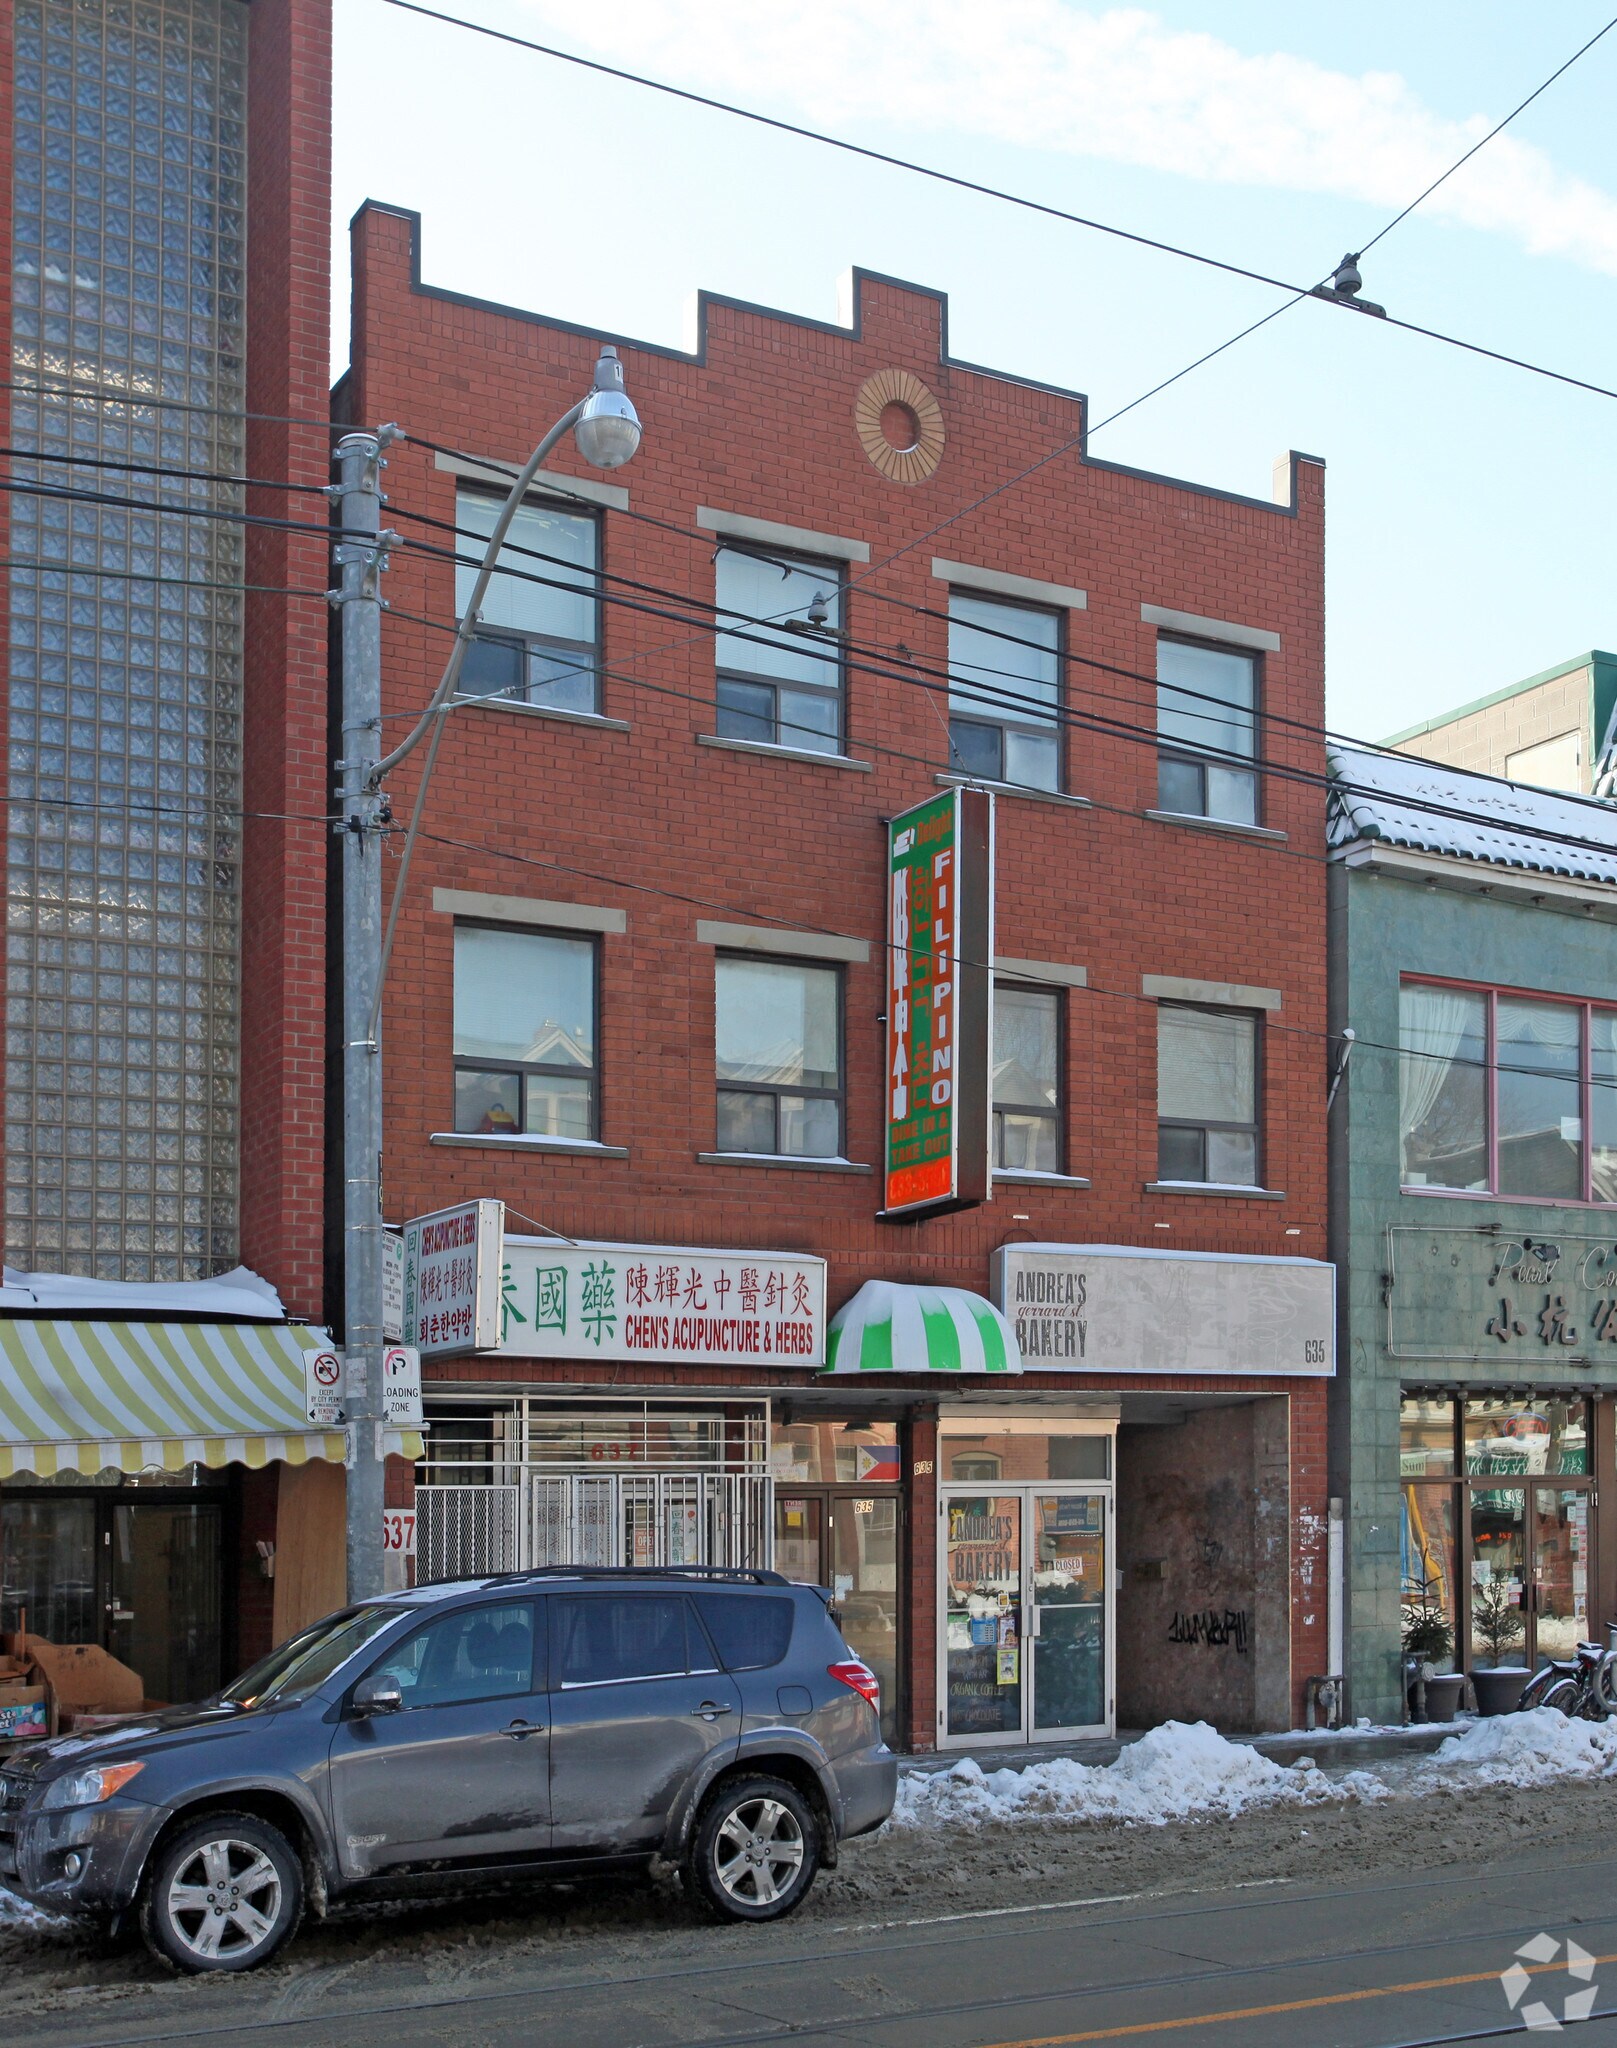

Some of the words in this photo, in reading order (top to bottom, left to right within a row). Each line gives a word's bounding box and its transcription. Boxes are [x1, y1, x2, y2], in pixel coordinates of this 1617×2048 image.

[932, 850, 953, 1105] FILIPINO
[891, 1120, 919, 1144] DINE
[923, 1116, 935, 1134] IN
[891, 1142, 921, 1166] TAKE
[924, 1133, 949, 1156] OUT
[626, 1263, 813, 1316] 陳輝光中醫針灸
[1016, 1271, 1087, 1305] ANDREA'S
[419, 1305, 473, 1346] 회춘한약방
[625, 1314, 669, 1350] CHEN'S
[672, 1316, 760, 1353] ACUPUNCTURE
[763, 1320, 771, 1353] &
[775, 1321, 813, 1355] HERBS
[1015, 1319, 1088, 1358] BAKERY
[1304, 1339, 1325, 1364] 635
[391, 1402, 410, 1412] ZONE
[1506, 1420, 1549, 1437] OPEN
[591, 1443, 639, 1461] 637
[914, 1461, 934, 1474] 635
[1402, 1459, 1425, 1472] Sum
[855, 1501, 874, 1513] 635
[956, 1516, 1013, 1541] ANDREA'S
[955, 1551, 1013, 1582] BAKERY
[1056, 1559, 1080, 1571] CLOSED
[950, 1683, 980, 1697] ORGANIC
[980, 1683, 1004, 1697] COFFEE
